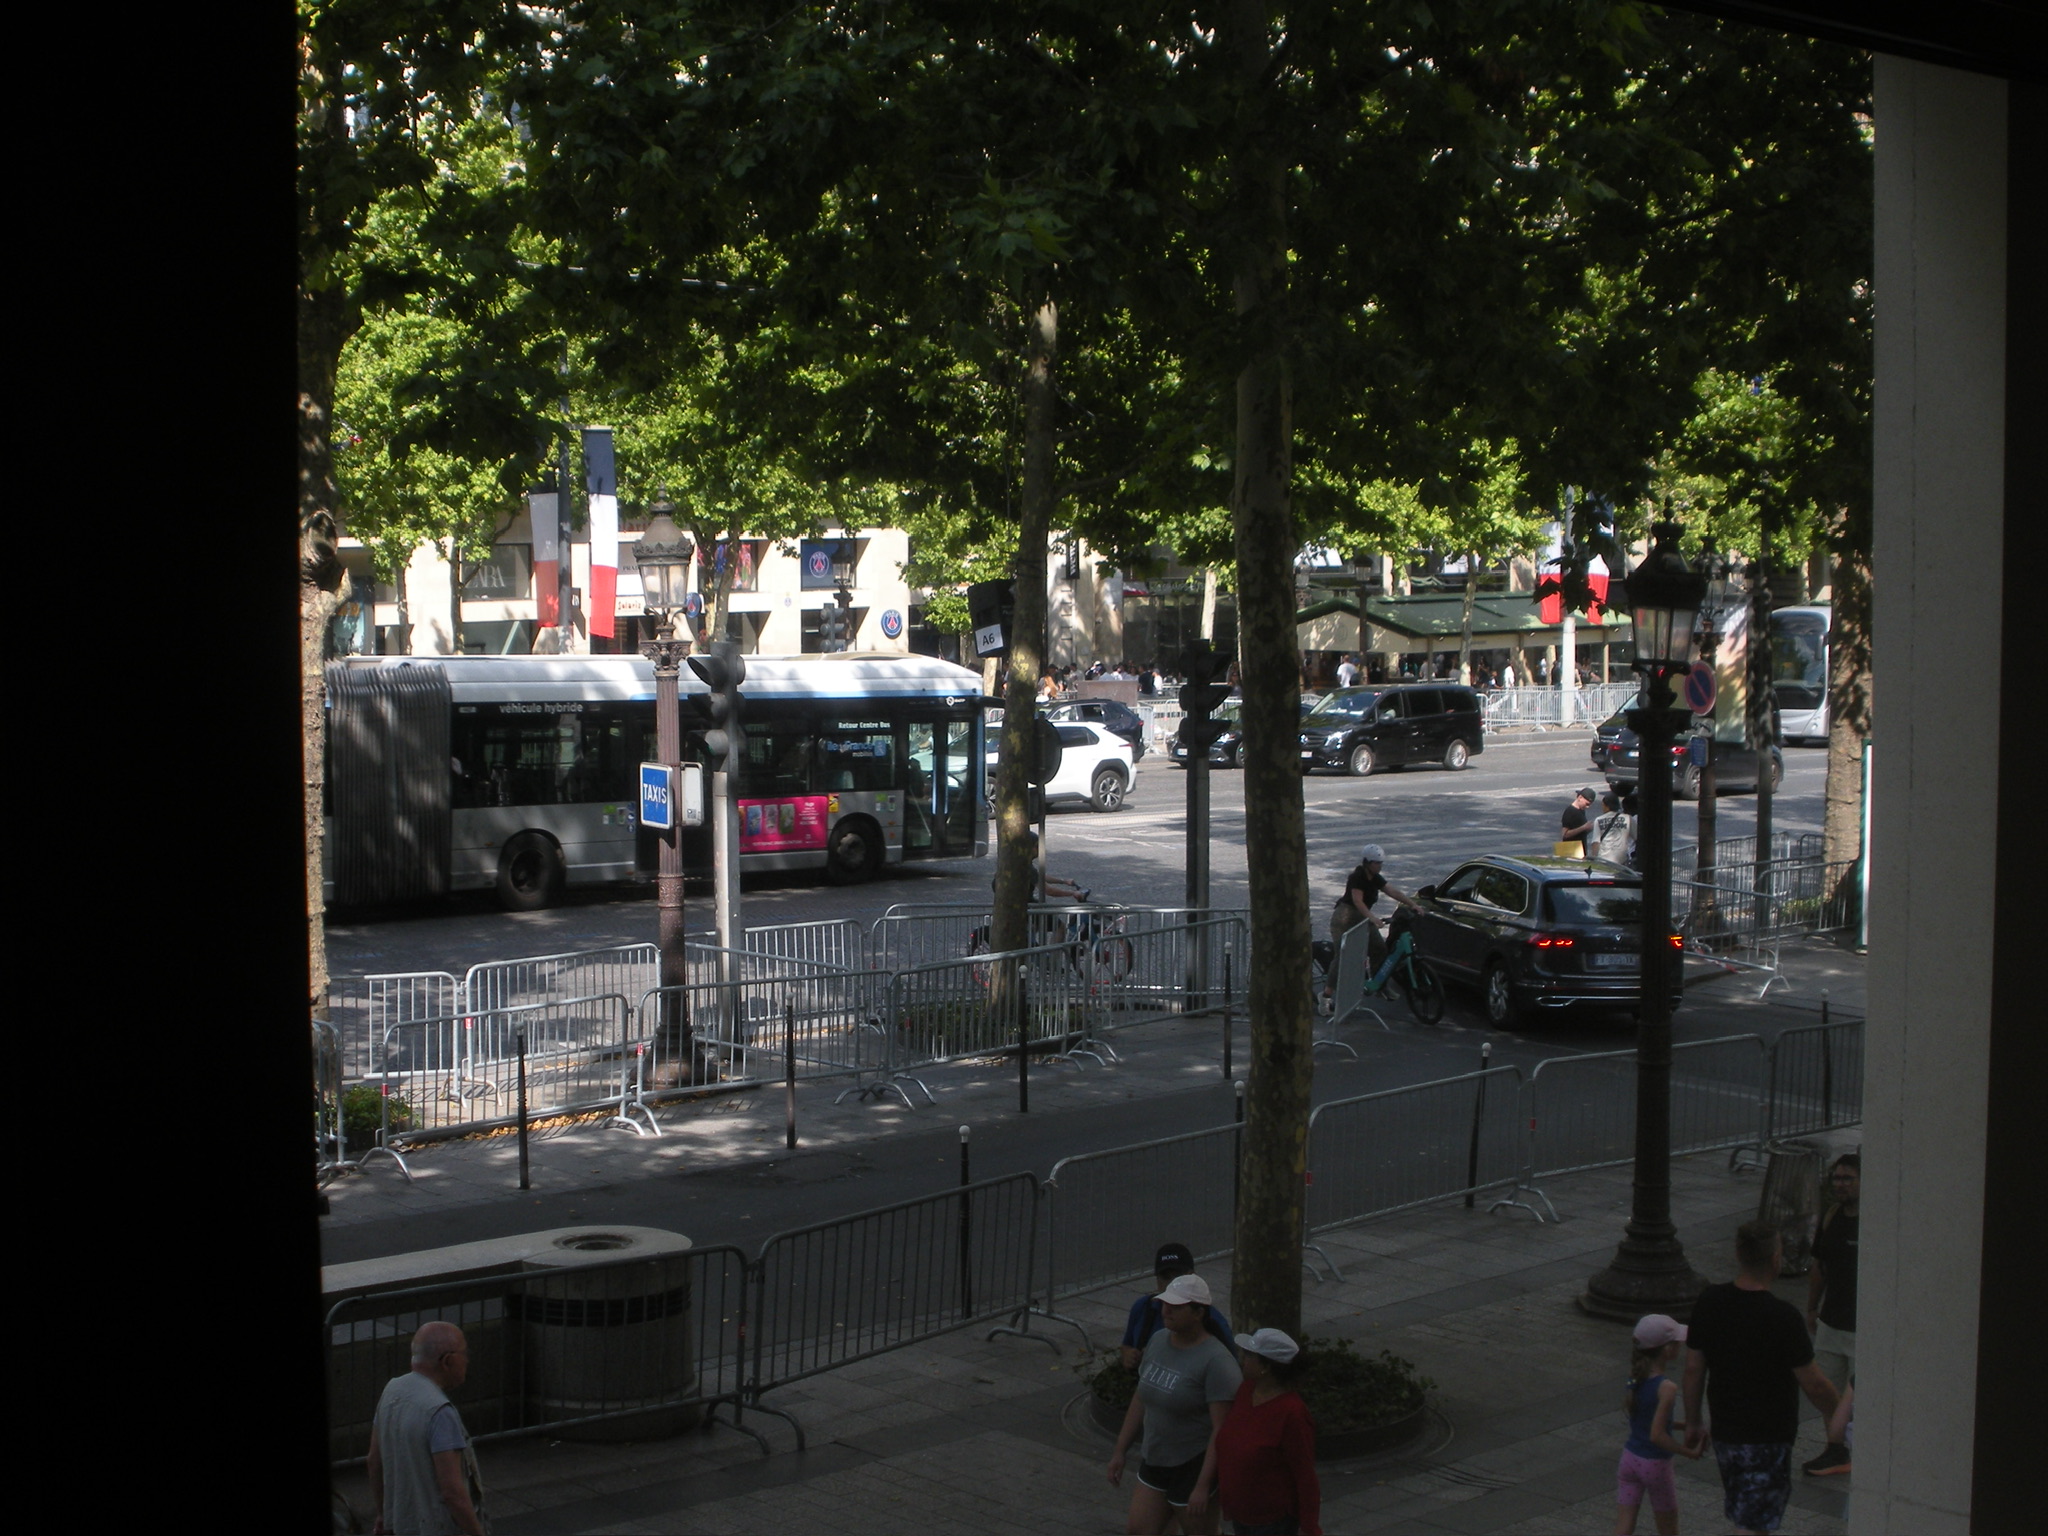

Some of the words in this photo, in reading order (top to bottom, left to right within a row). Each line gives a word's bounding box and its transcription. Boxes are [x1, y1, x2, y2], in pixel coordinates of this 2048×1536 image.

[464, 565, 506, 588] ZARA
[982, 633, 995, 646] A6
[499, 703, 542, 714] véhicule
[544, 702, 583, 714] hybride
[860, 721, 878, 729] Centre
[643, 783, 667, 804] TAXIS
